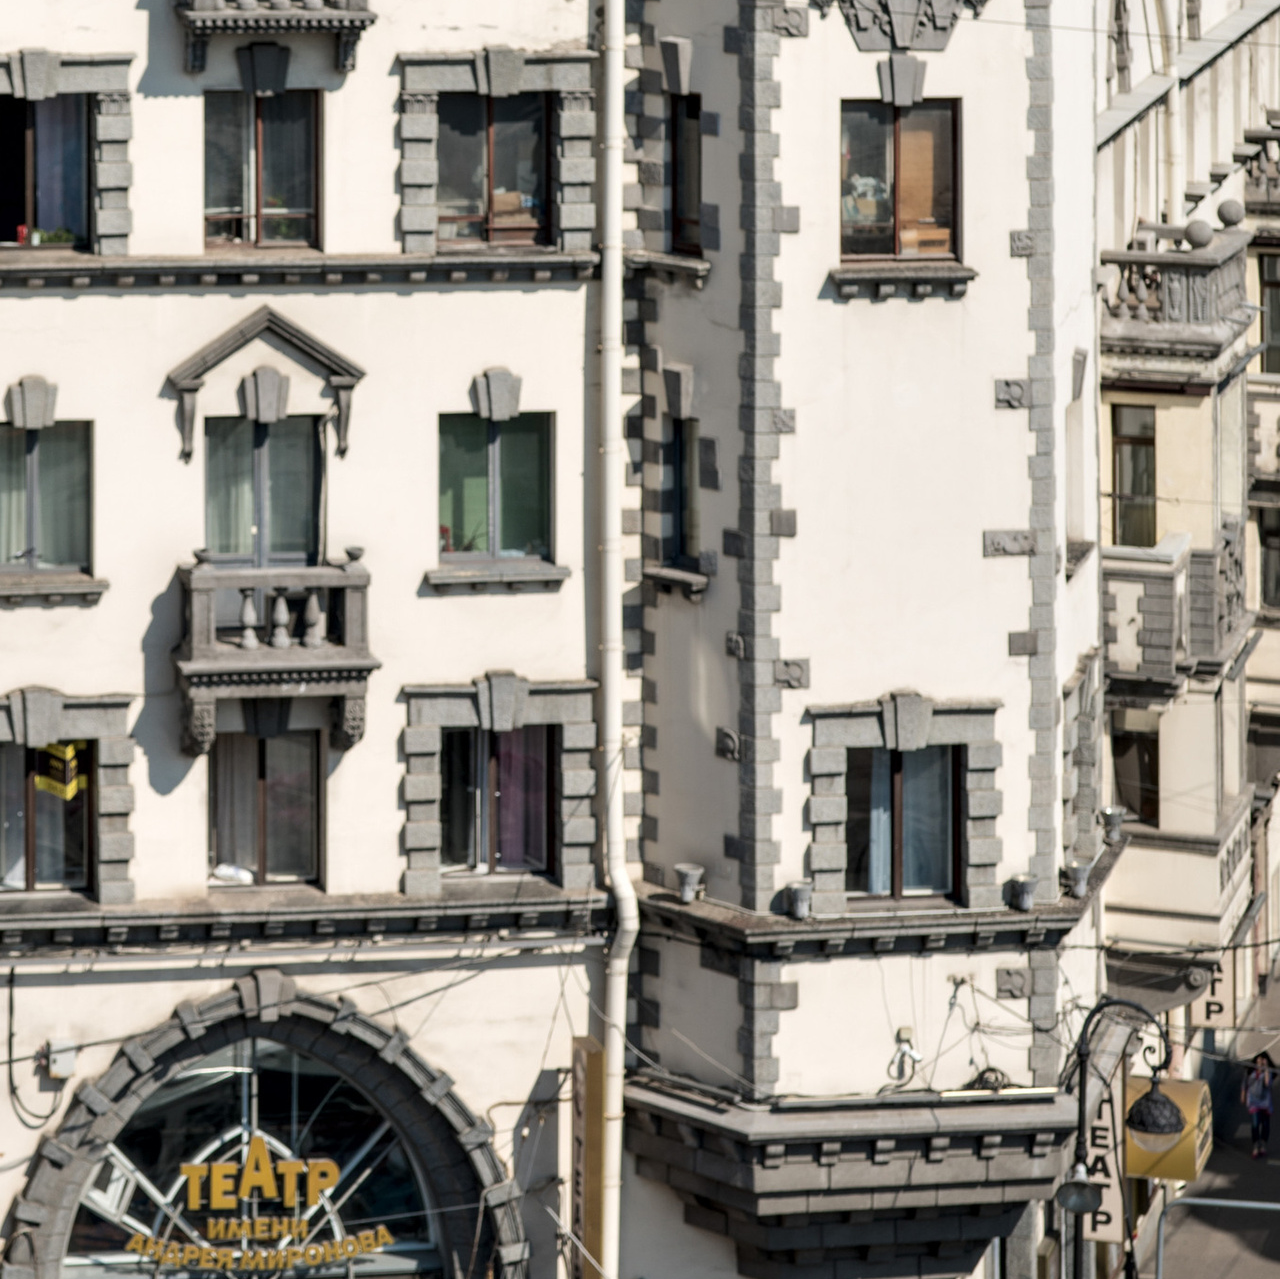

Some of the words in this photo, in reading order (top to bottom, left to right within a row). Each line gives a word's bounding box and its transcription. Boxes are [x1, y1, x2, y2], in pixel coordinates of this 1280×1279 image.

[180, 1135, 341, 1211] ТЕАТР
[125, 1232, 233, 1271] АНДРЕЯ
[239, 1223, 396, 1271] МИРОНОВА
[207, 1217, 309, 1240] ИМЕНИ
